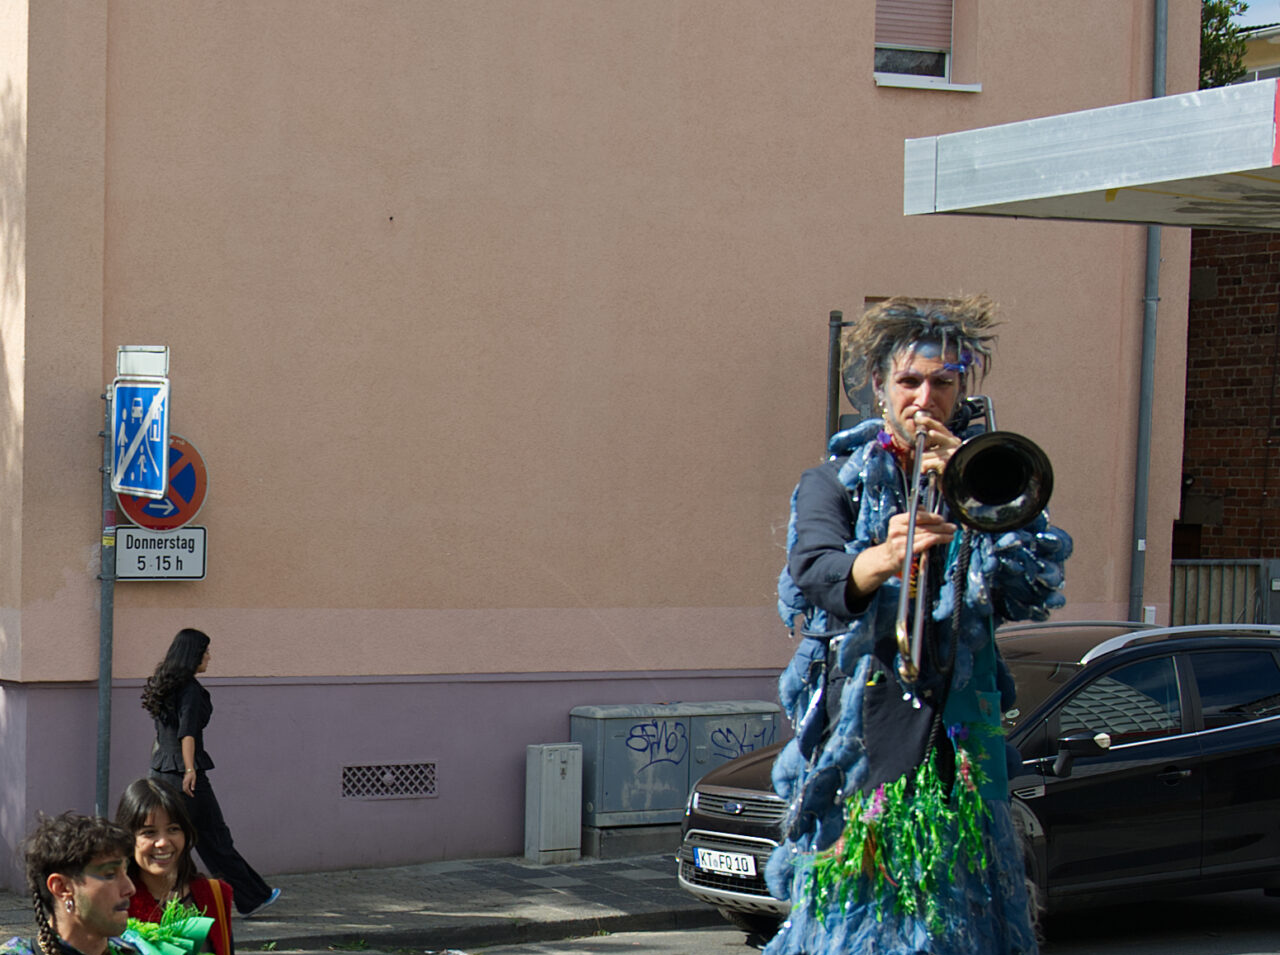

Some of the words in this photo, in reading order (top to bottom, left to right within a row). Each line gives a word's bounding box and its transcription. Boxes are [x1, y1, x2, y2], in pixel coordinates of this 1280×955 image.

[126, 534, 195, 554] Donnerstag
[137, 556, 146, 571] 5
[176, 555, 183, 571] h
